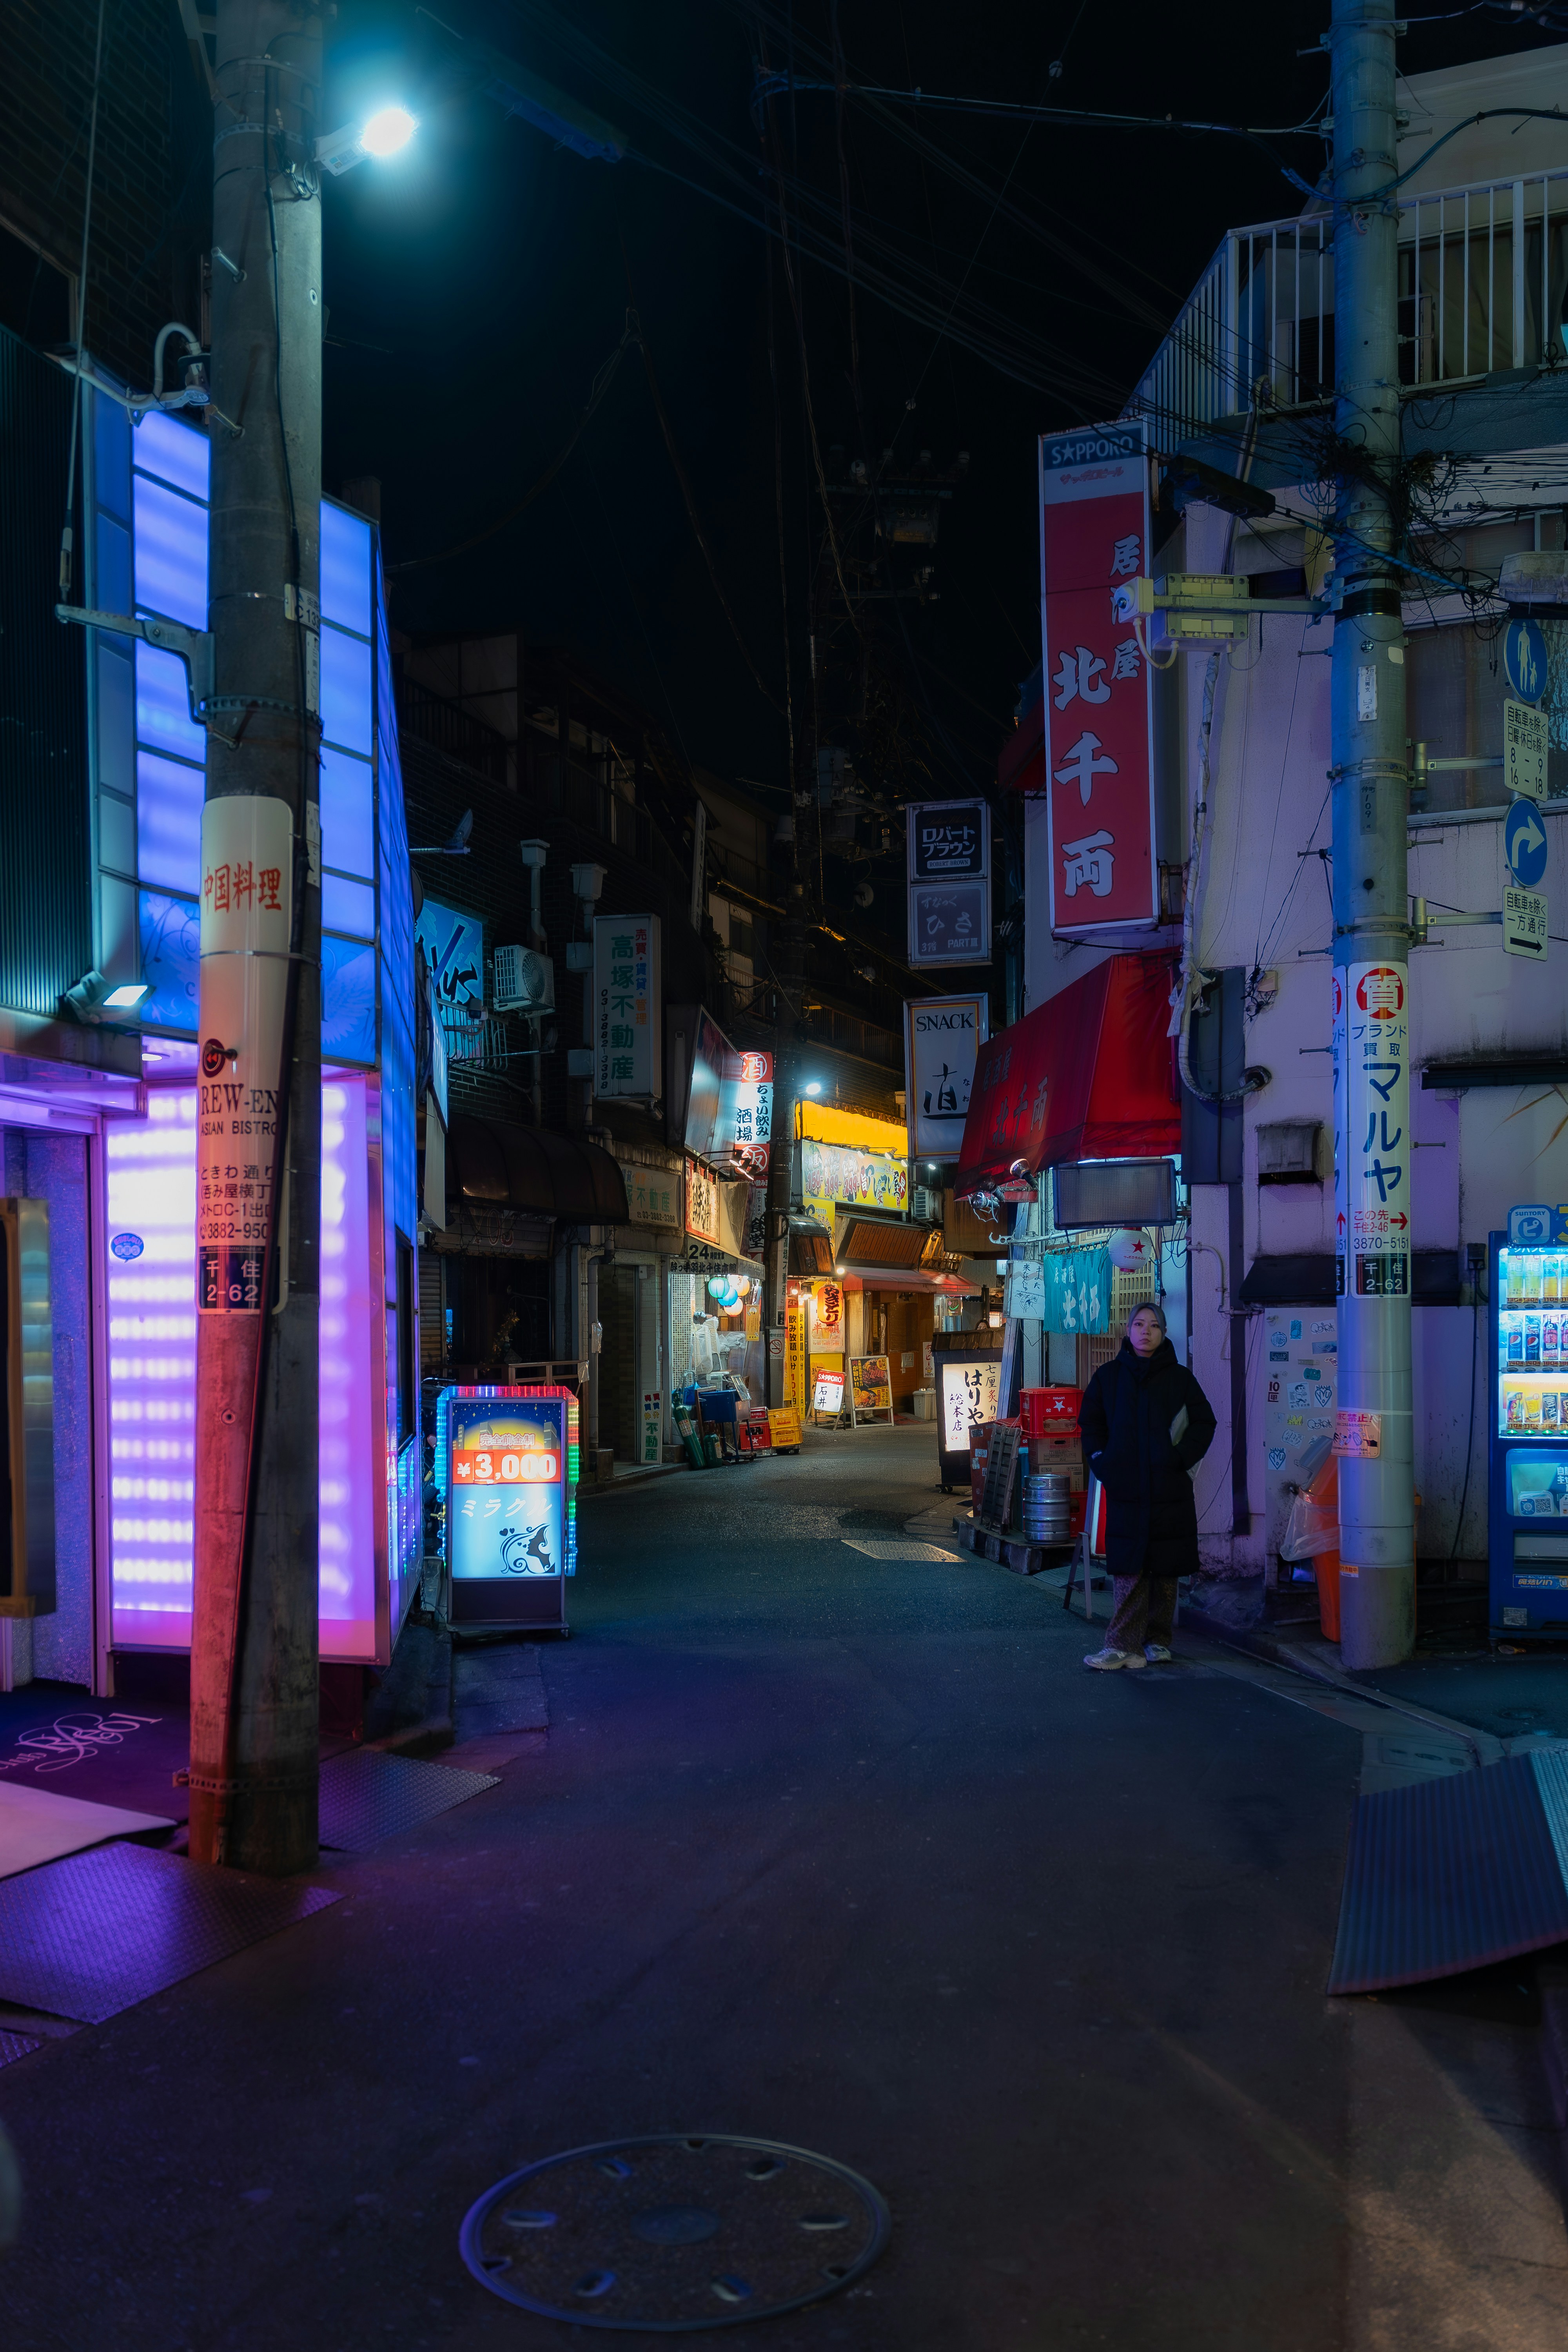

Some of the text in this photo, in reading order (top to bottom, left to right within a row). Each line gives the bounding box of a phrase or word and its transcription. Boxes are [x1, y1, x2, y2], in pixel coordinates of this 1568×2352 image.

[1109, 534, 1142, 681] 居屋
[1508, 706, 1546, 735] 自転車を除く
[1052, 645, 1119, 898] 北千両
[922, 826, 975, 843] ロバート
[922, 842, 975, 858] ブラウン
[204, 860, 282, 916] 中国料理
[1507, 891, 1546, 916] 自転車を除く
[1507, 915, 1546, 936] 一方通行
[635, 928, 647, 1025] 売買・賃貸・管理
[1360, 975, 1402, 1016] 質
[611, 935, 634, 1080] 高塚不動産
[916, 1013, 974, 1031] SNACK
[1352, 1025, 1406, 1040] ブランド
[1363, 1043, 1400, 1057] 買取
[755, 1084, 769, 1136] ちょい飲み
[201, 1120, 223, 1136] ASIAN
[737, 1108, 753, 1142] 酒場
[1363, 1063, 1402, 1202] マルヤ
[1354, 1210, 1388, 1221] この先
[1354, 1222, 1388, 1233] 千住2-46
[1354, 1237, 1408, 1249] 3870-5151
[206, 1259, 260, 1278] 千住
[1034, 1266, 1042, 1289] また
[1365, 1263, 1403, 1274] 千住
[207, 1283, 259, 1301] 2-62
[1366, 1279, 1402, 1290] 2-62
[824, 1287, 839, 1321] やきとり
[817, 1386, 827, 1408] 石井
[965, 1369, 984, 1425] はりや
[985, 1365, 998, 1415] 七厘炙り
[1269, 1381, 1279, 1391] 10
[949, 1393, 964, 1431] 総本店
[479, 1433, 535, 1446] 完全前金制
[645, 1422, 658, 1461] 不動産
[461, 1497, 552, 1518] ミラクル
